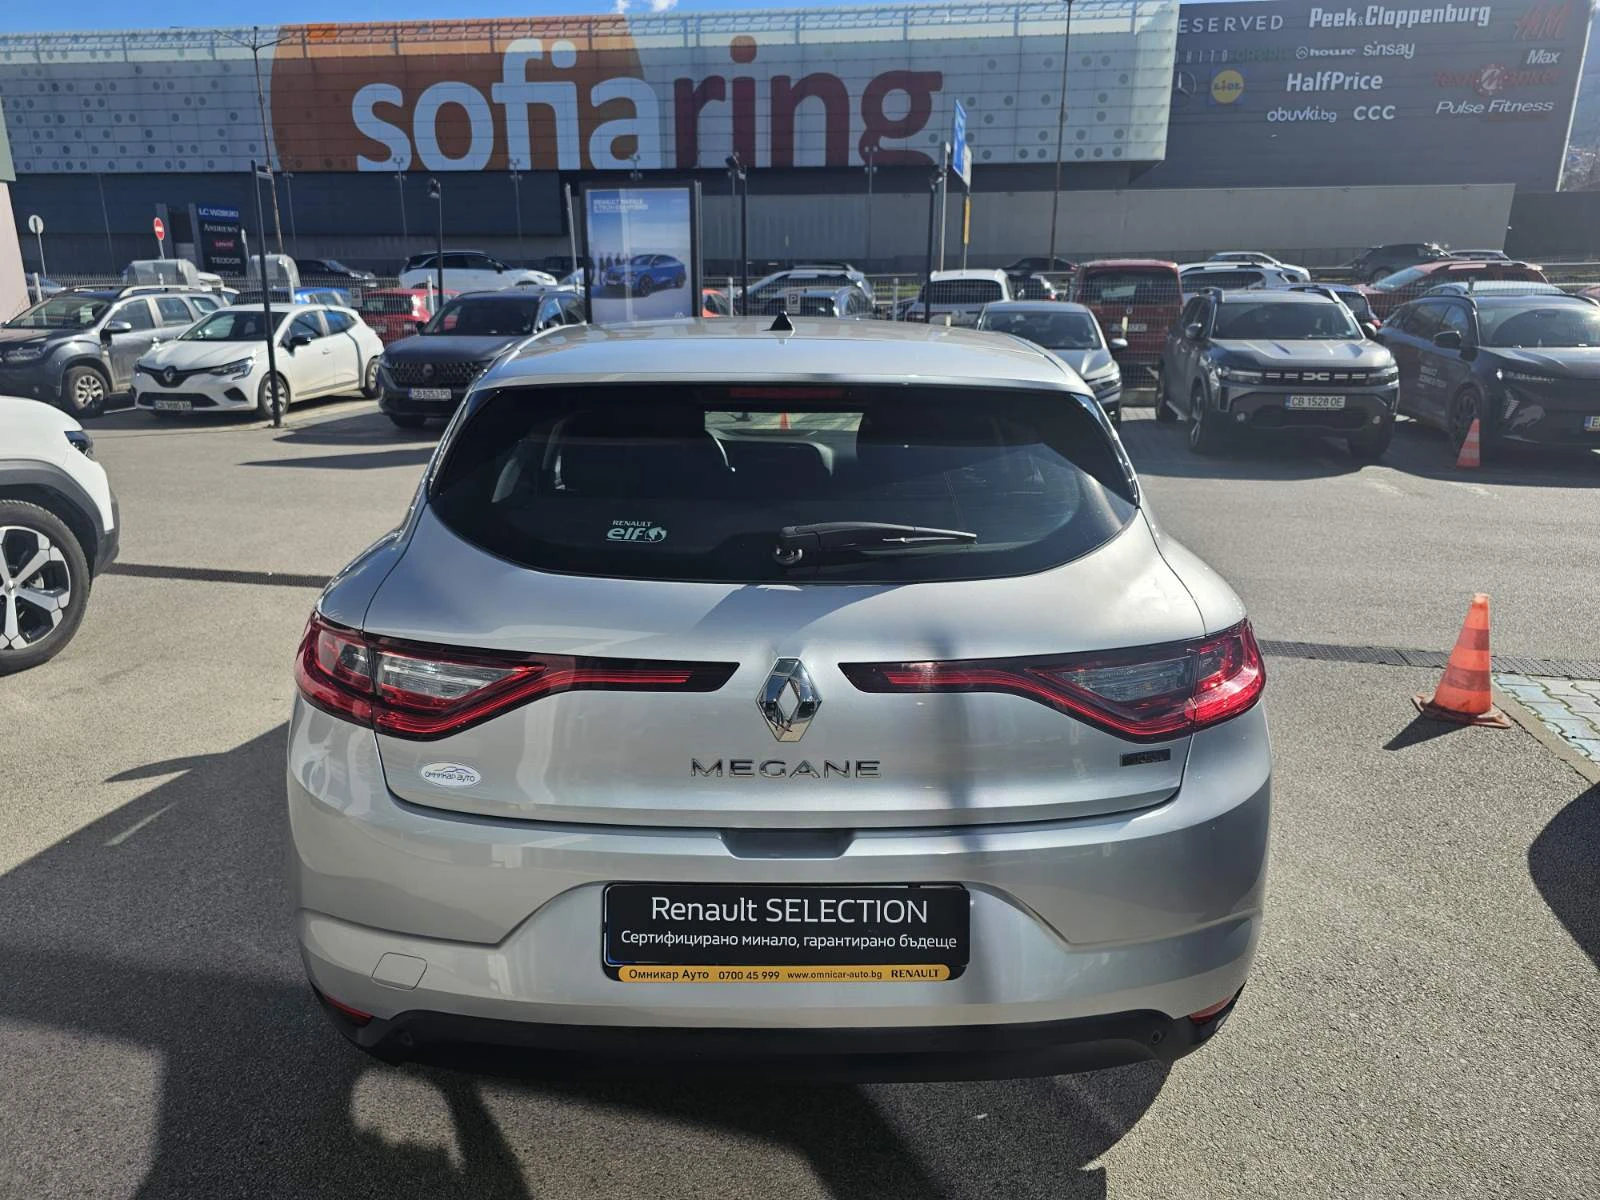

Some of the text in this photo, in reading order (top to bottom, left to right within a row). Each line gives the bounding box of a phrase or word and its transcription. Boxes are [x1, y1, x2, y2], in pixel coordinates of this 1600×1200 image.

[1178, 15, 1284, 34] ESERVED
[1363, 40, 1416, 60] sinsay
[1528, 49, 1561, 65] Max
[1286, 70, 1384, 92] HalfPrice
[352, 35, 943, 171] sofiaring
[1435, 99, 1556, 114] Pulse Fitness
[1266, 106, 1338, 123] obuvki.bg
[1353, 105, 1397, 121] CCC
[607, 527, 647, 540] elf
[690, 757, 882, 779] MEGANE
[652, 896, 928, 924] Renault SELECTION
[621, 930, 957, 950] Сертифицирано минало, гарантирано бъдеще
[629, 969, 940, 981] Омникар Ауто 0700 45 999 www.omnicar-auto.bg RENAULT
